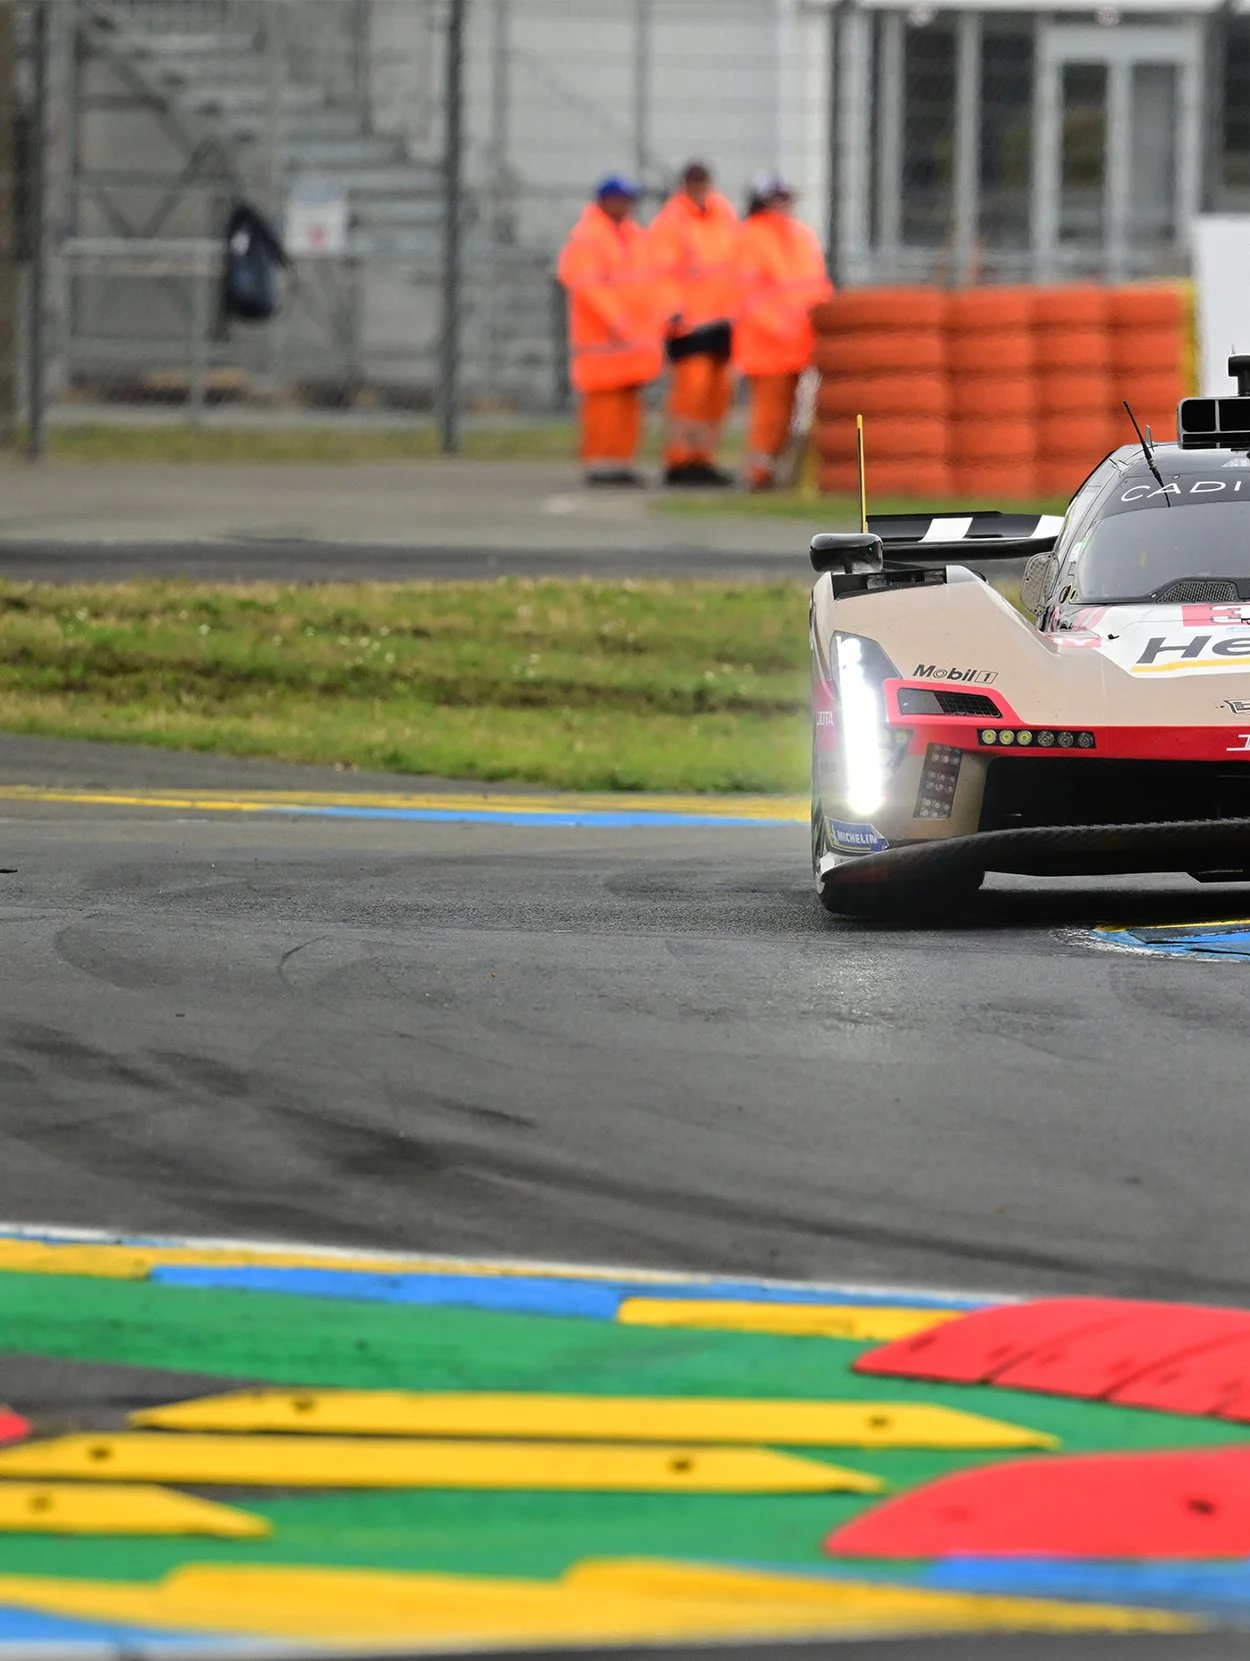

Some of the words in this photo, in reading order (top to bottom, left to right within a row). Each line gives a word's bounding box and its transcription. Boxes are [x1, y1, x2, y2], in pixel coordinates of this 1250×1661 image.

[912, 664, 977, 682] Mobil
[816, 711, 834, 726] JOTA
[836, 830, 878, 844] MICHELIN
